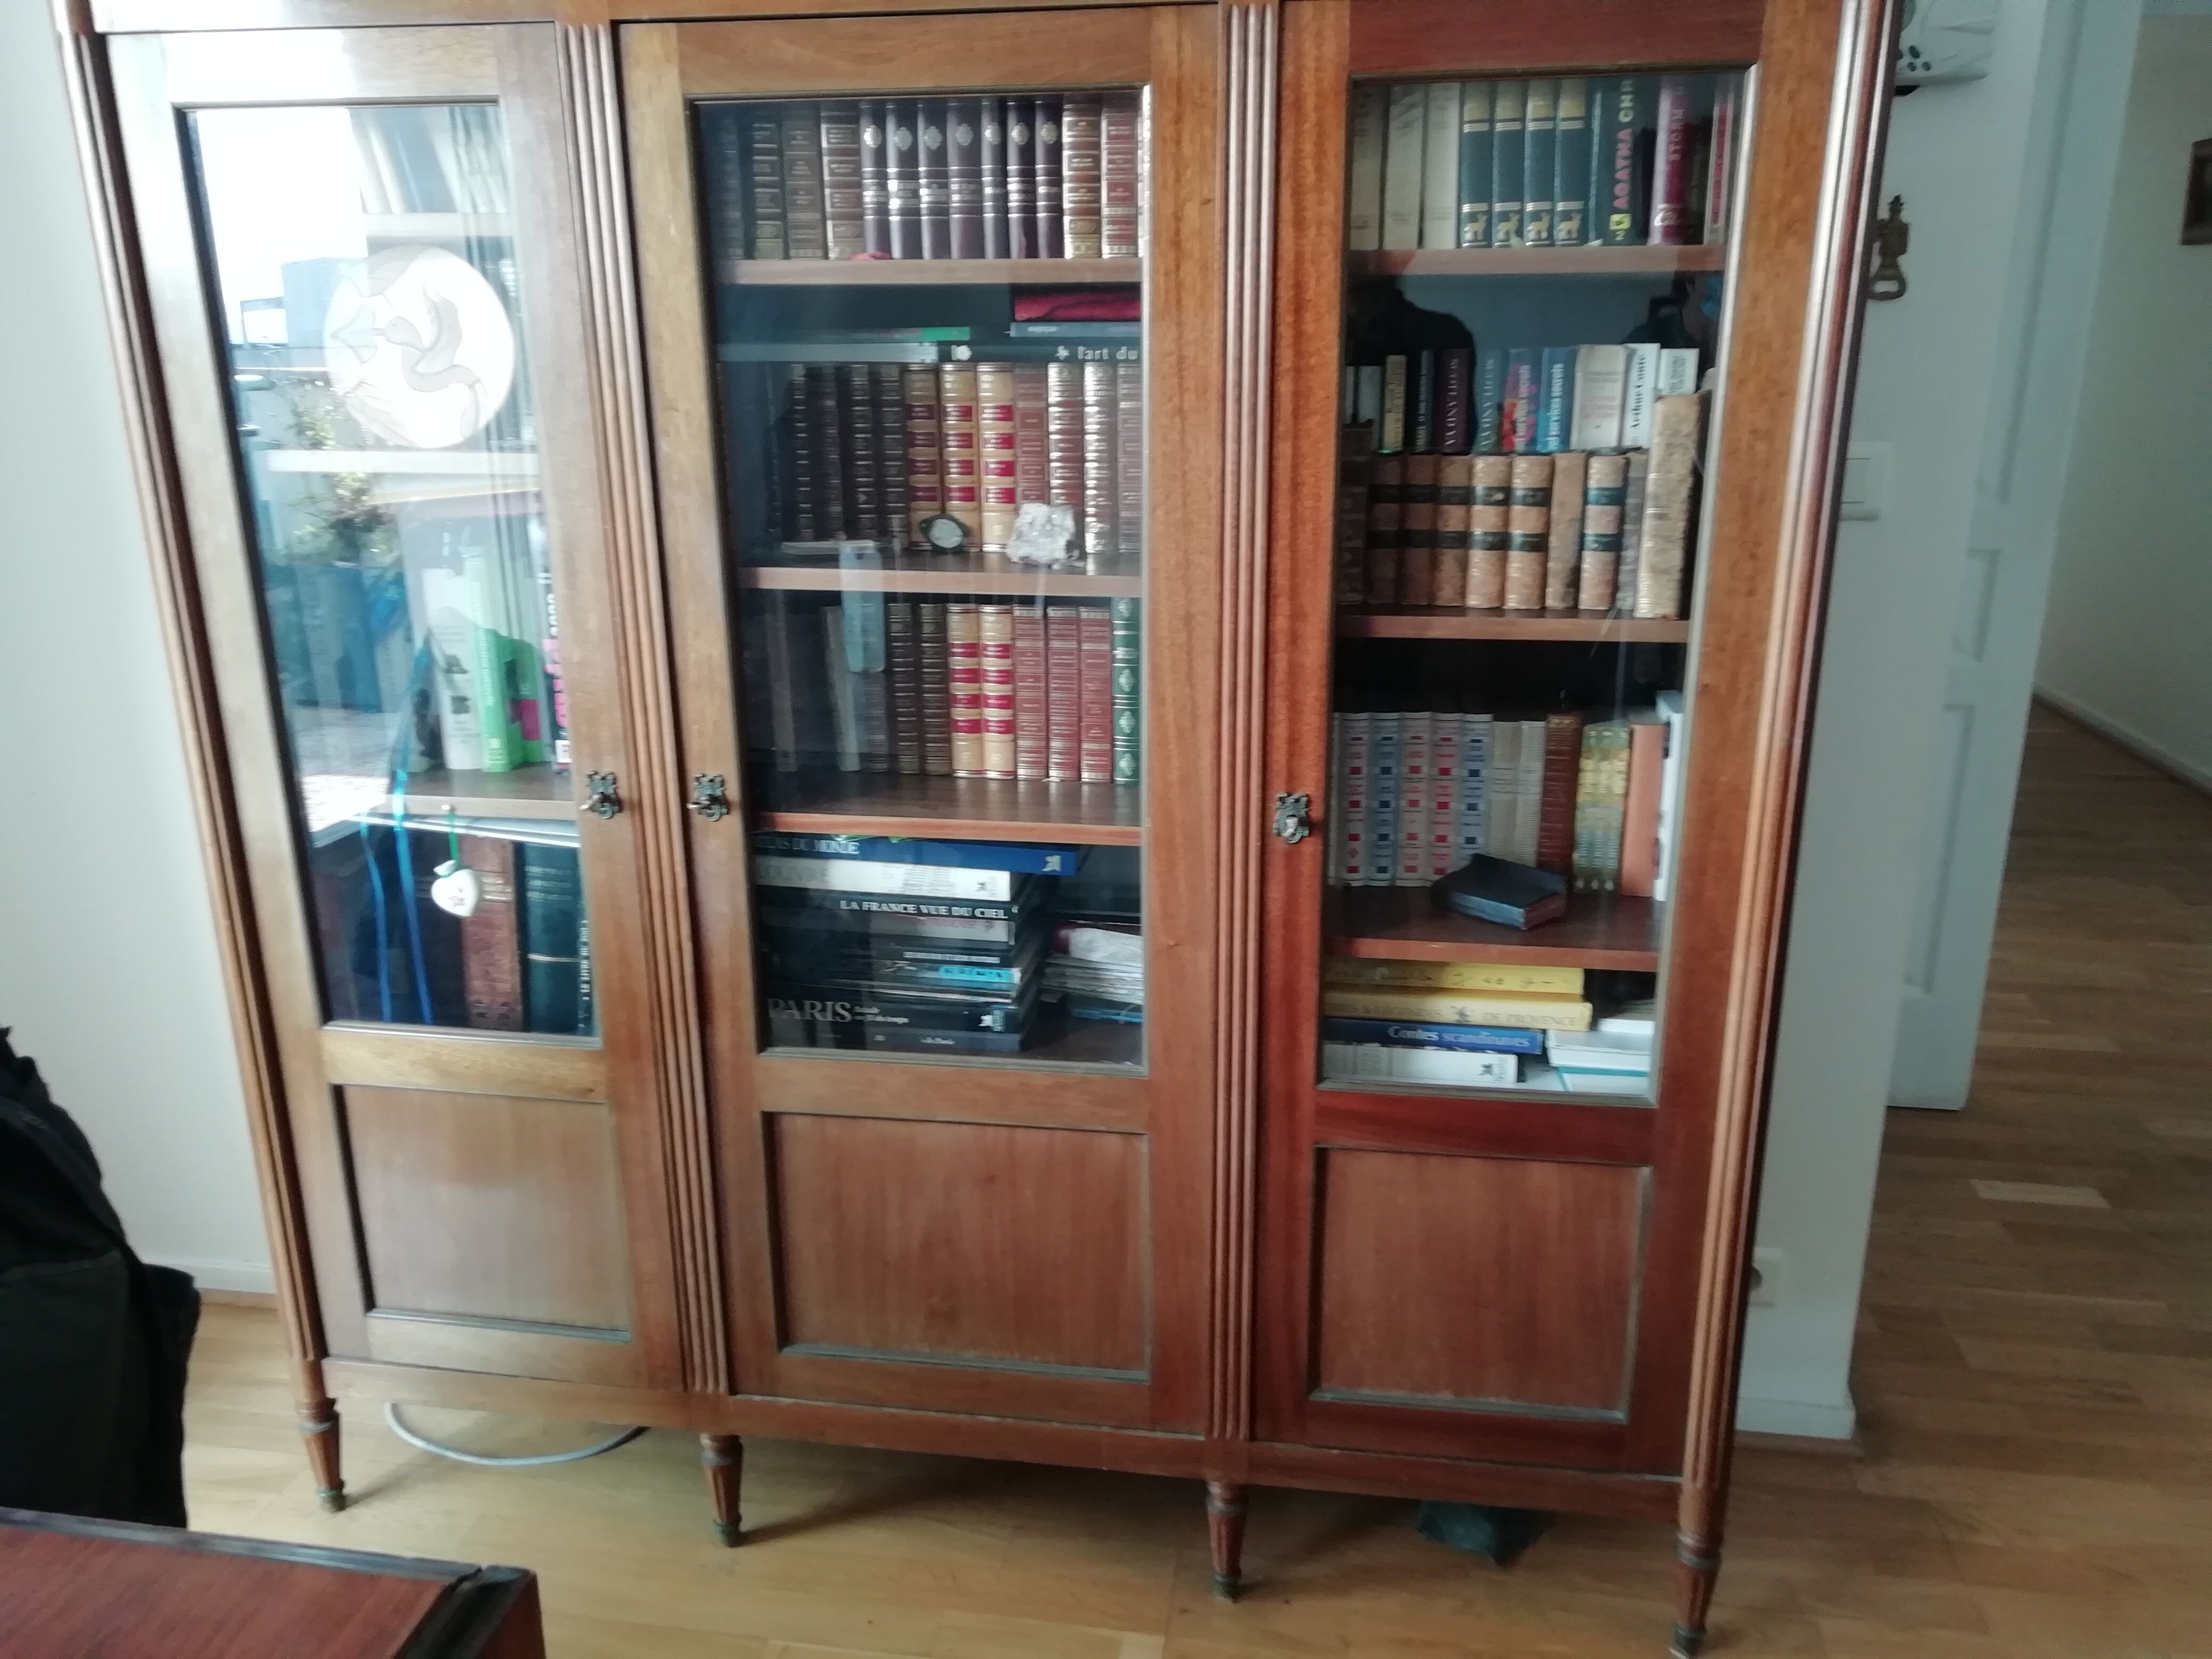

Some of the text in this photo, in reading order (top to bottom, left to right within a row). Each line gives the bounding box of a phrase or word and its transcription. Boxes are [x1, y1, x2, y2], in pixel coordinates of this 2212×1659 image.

[1612, 129, 1632, 211] AGATHA
[1078, 346, 1138, 360] l'art du
[840, 900, 1009, 919] LA FRANCE VUE DU CIEL
[767, 998, 852, 1023] PARIS
